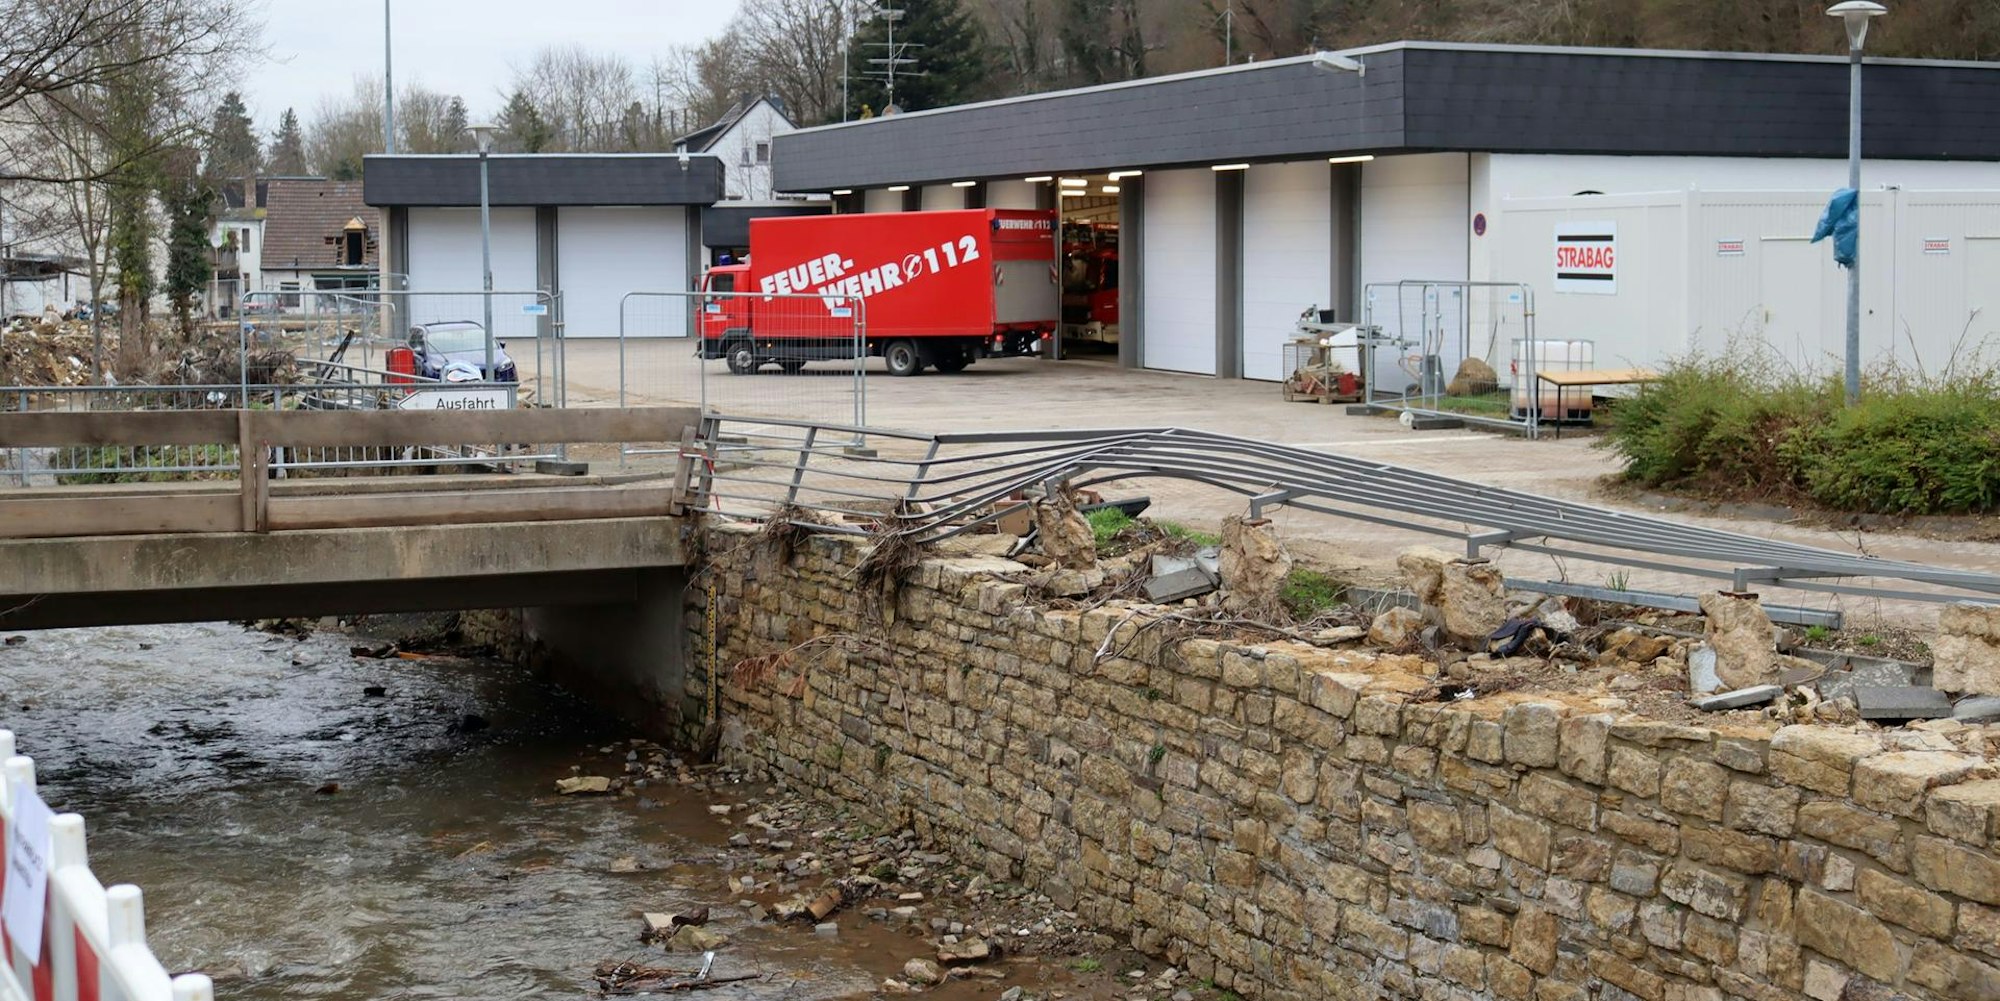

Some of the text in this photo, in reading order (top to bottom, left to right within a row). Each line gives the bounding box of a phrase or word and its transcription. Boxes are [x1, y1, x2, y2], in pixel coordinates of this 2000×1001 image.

[818, 235, 980, 310] WEHR 112
[1556, 246, 1614, 268] STRABAG
[760, 253, 854, 302] FEUER-
[436, 397, 495, 409] Ausfahrt
